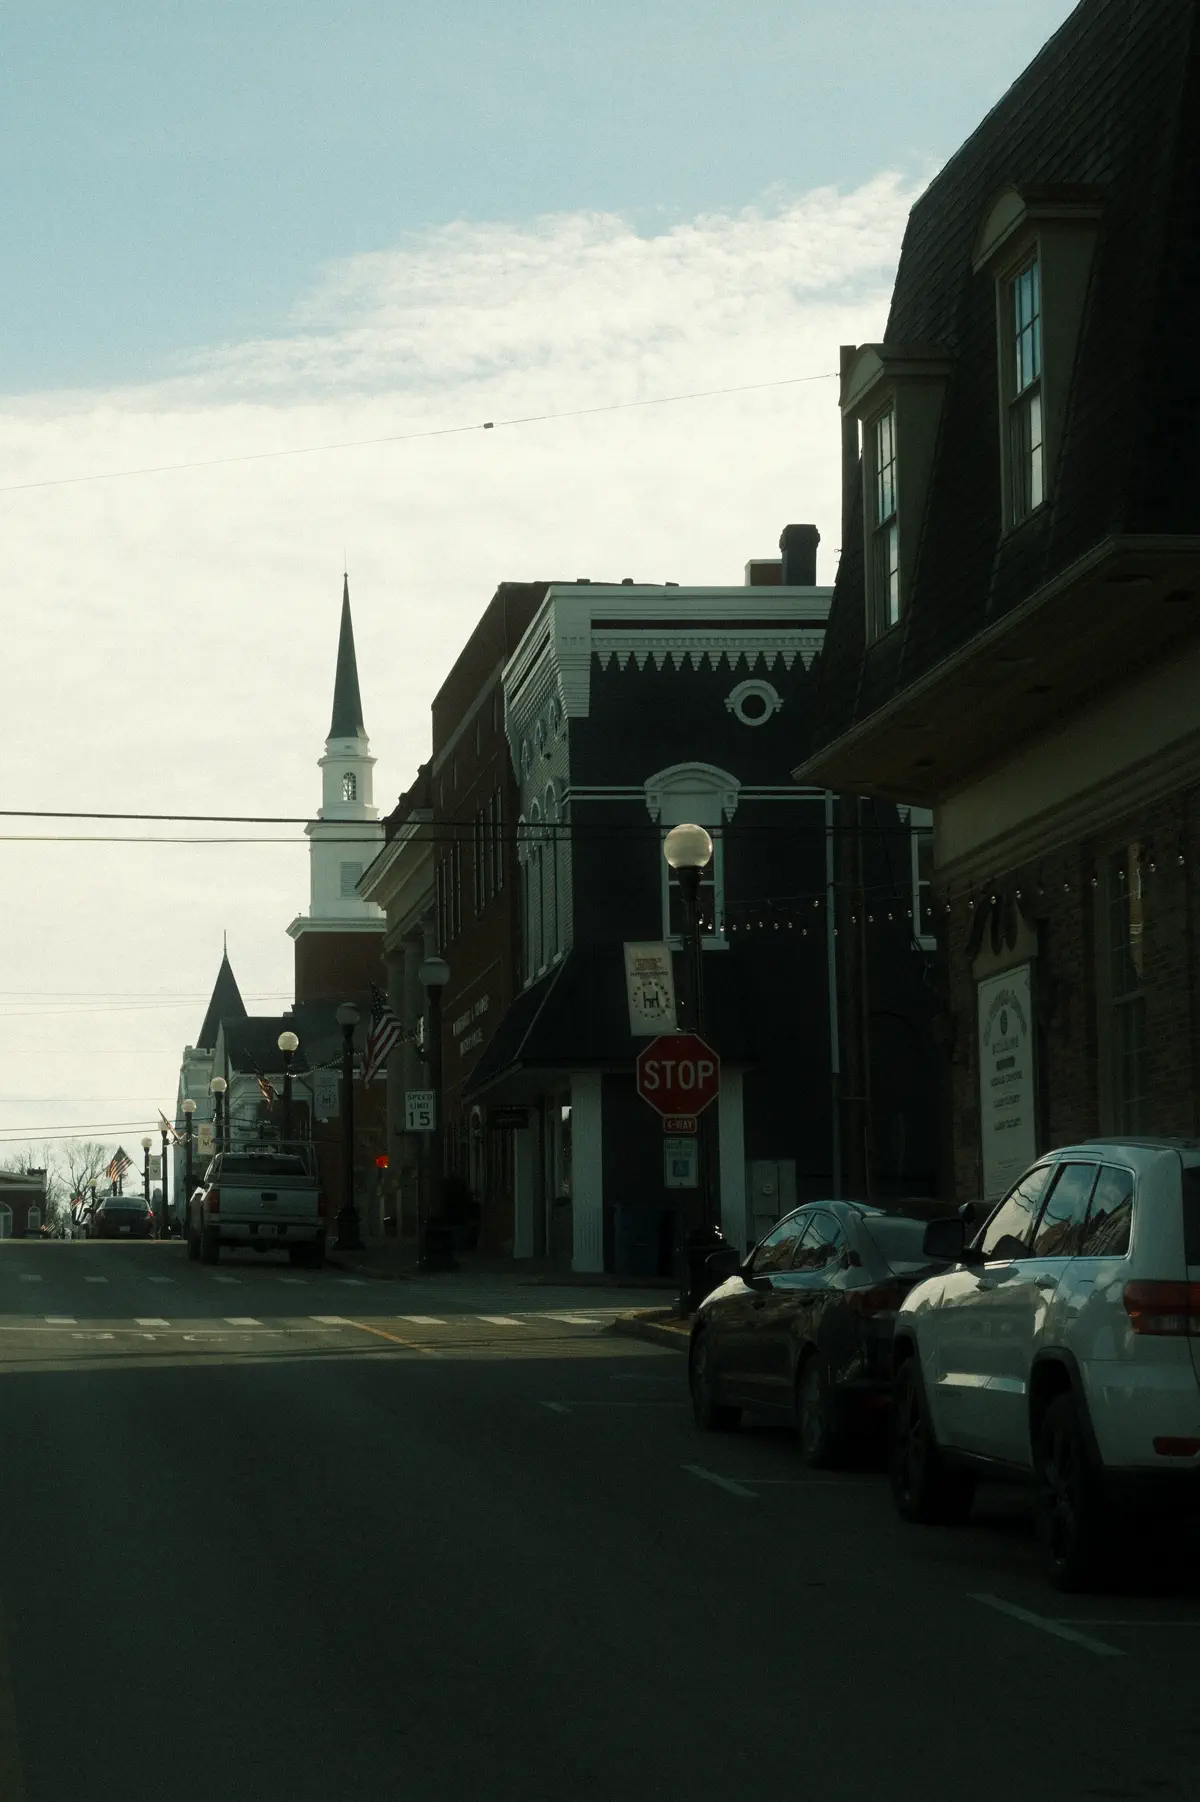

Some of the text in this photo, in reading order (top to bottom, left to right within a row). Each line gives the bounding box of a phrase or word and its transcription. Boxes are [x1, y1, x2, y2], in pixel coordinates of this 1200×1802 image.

[643, 1060, 715, 1090] STOP
[409, 1111, 430, 1127] 15
[667, 1119, 693, 1130] 4-WAY
